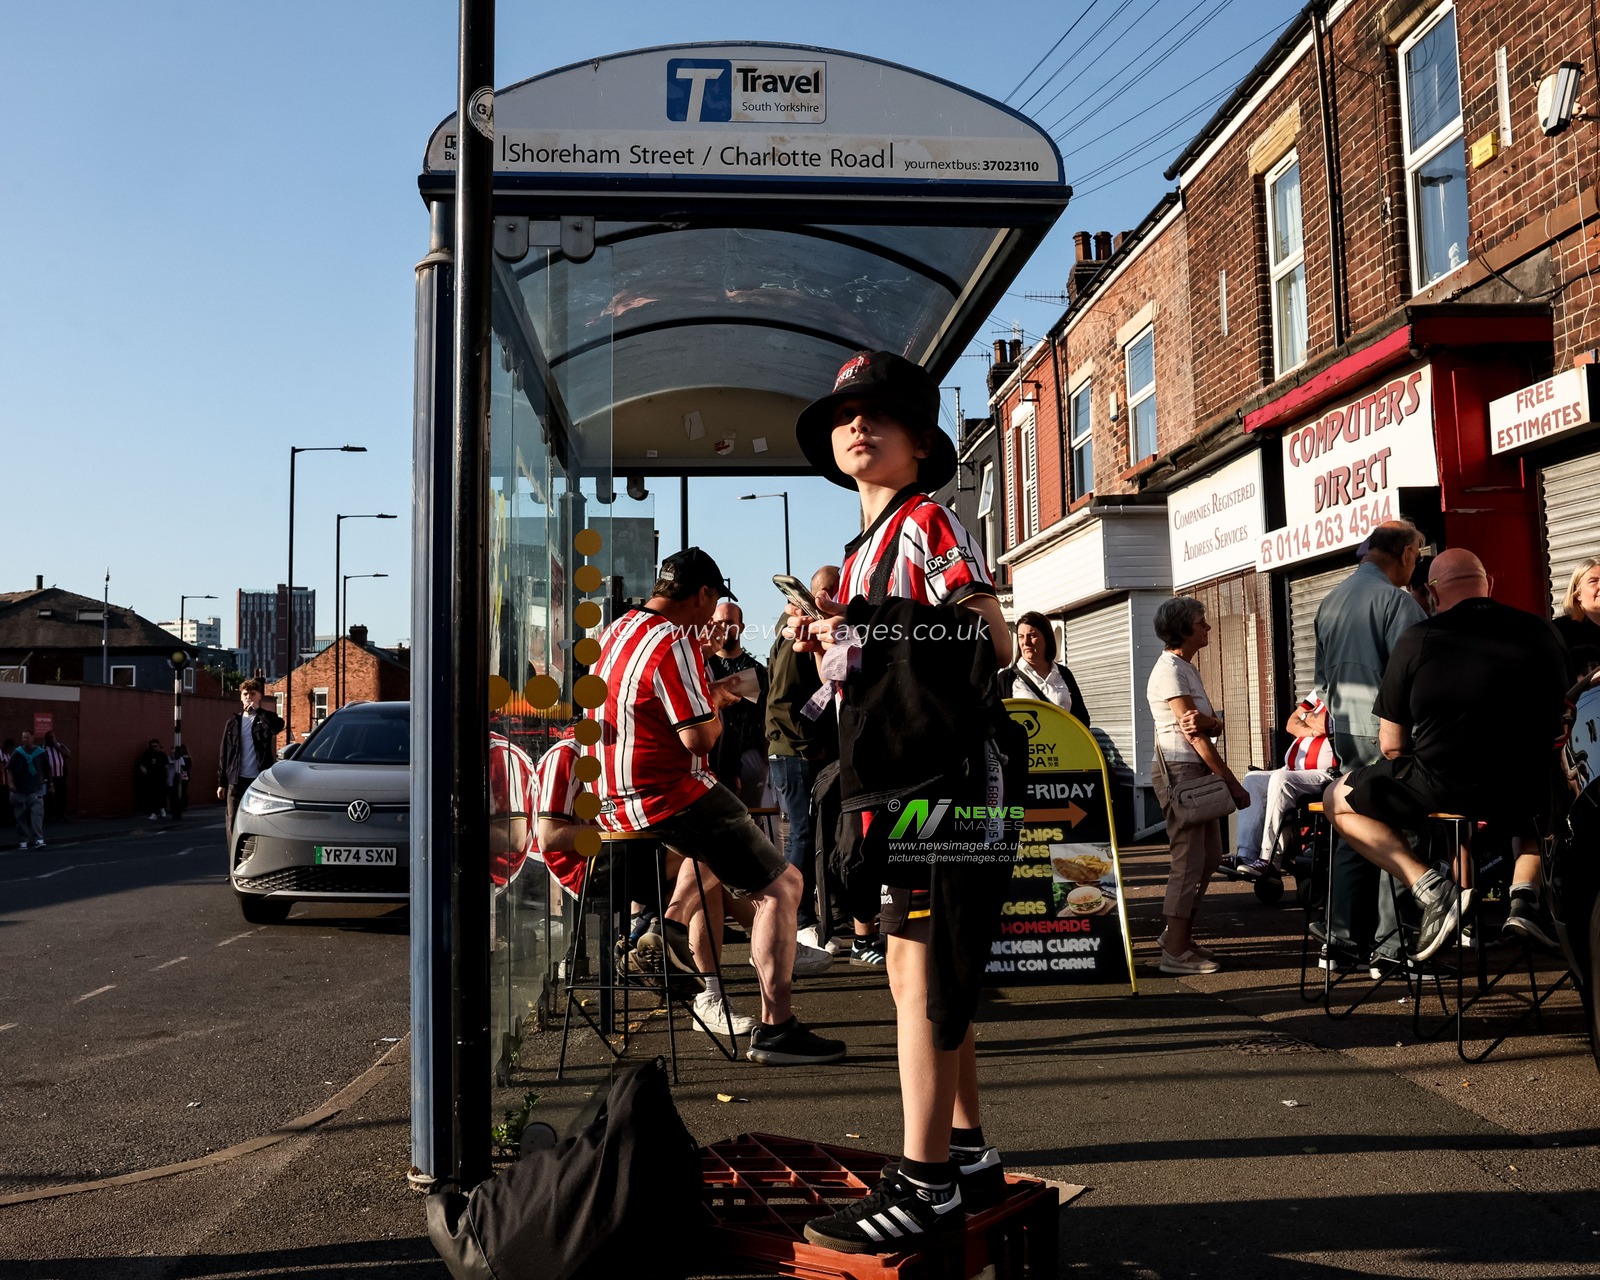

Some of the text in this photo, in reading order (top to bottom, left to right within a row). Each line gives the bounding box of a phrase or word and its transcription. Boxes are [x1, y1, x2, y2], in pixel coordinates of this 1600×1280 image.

[736, 67, 820, 93] Travel
[742, 102, 820, 113] South Yorkshire
[508, 142, 620, 164] Shoreham
[629, 145, 695, 165] Street
[720, 146, 821, 167] Charlotte
[831, 149, 885, 168] Road
[904, 159, 1039, 172] yournextbus: 37023110
[1516, 380, 1555, 414] FREE
[1289, 371, 1422, 468] COMPUTERS
[1497, 401, 1582, 450] ESTIMATES
[1314, 447, 1392, 514] DIRECT
[1276, 495, 1393, 561] 0114 263 4544
[927, 555, 947, 570] DR.
[1028, 743, 1057, 754] GRY
[324, 848, 394, 863] YR74 SXN
[1017, 845, 1050, 858] KES
[1012, 864, 1053, 878] AGES
[1001, 901, 1047, 915] GERS
[1001, 919, 1091, 935] HOMEMADE
[1046, 937, 1100, 953] CURRY
[1017, 959, 1048, 972] CON
[1050, 957, 1096, 970] CARNE
